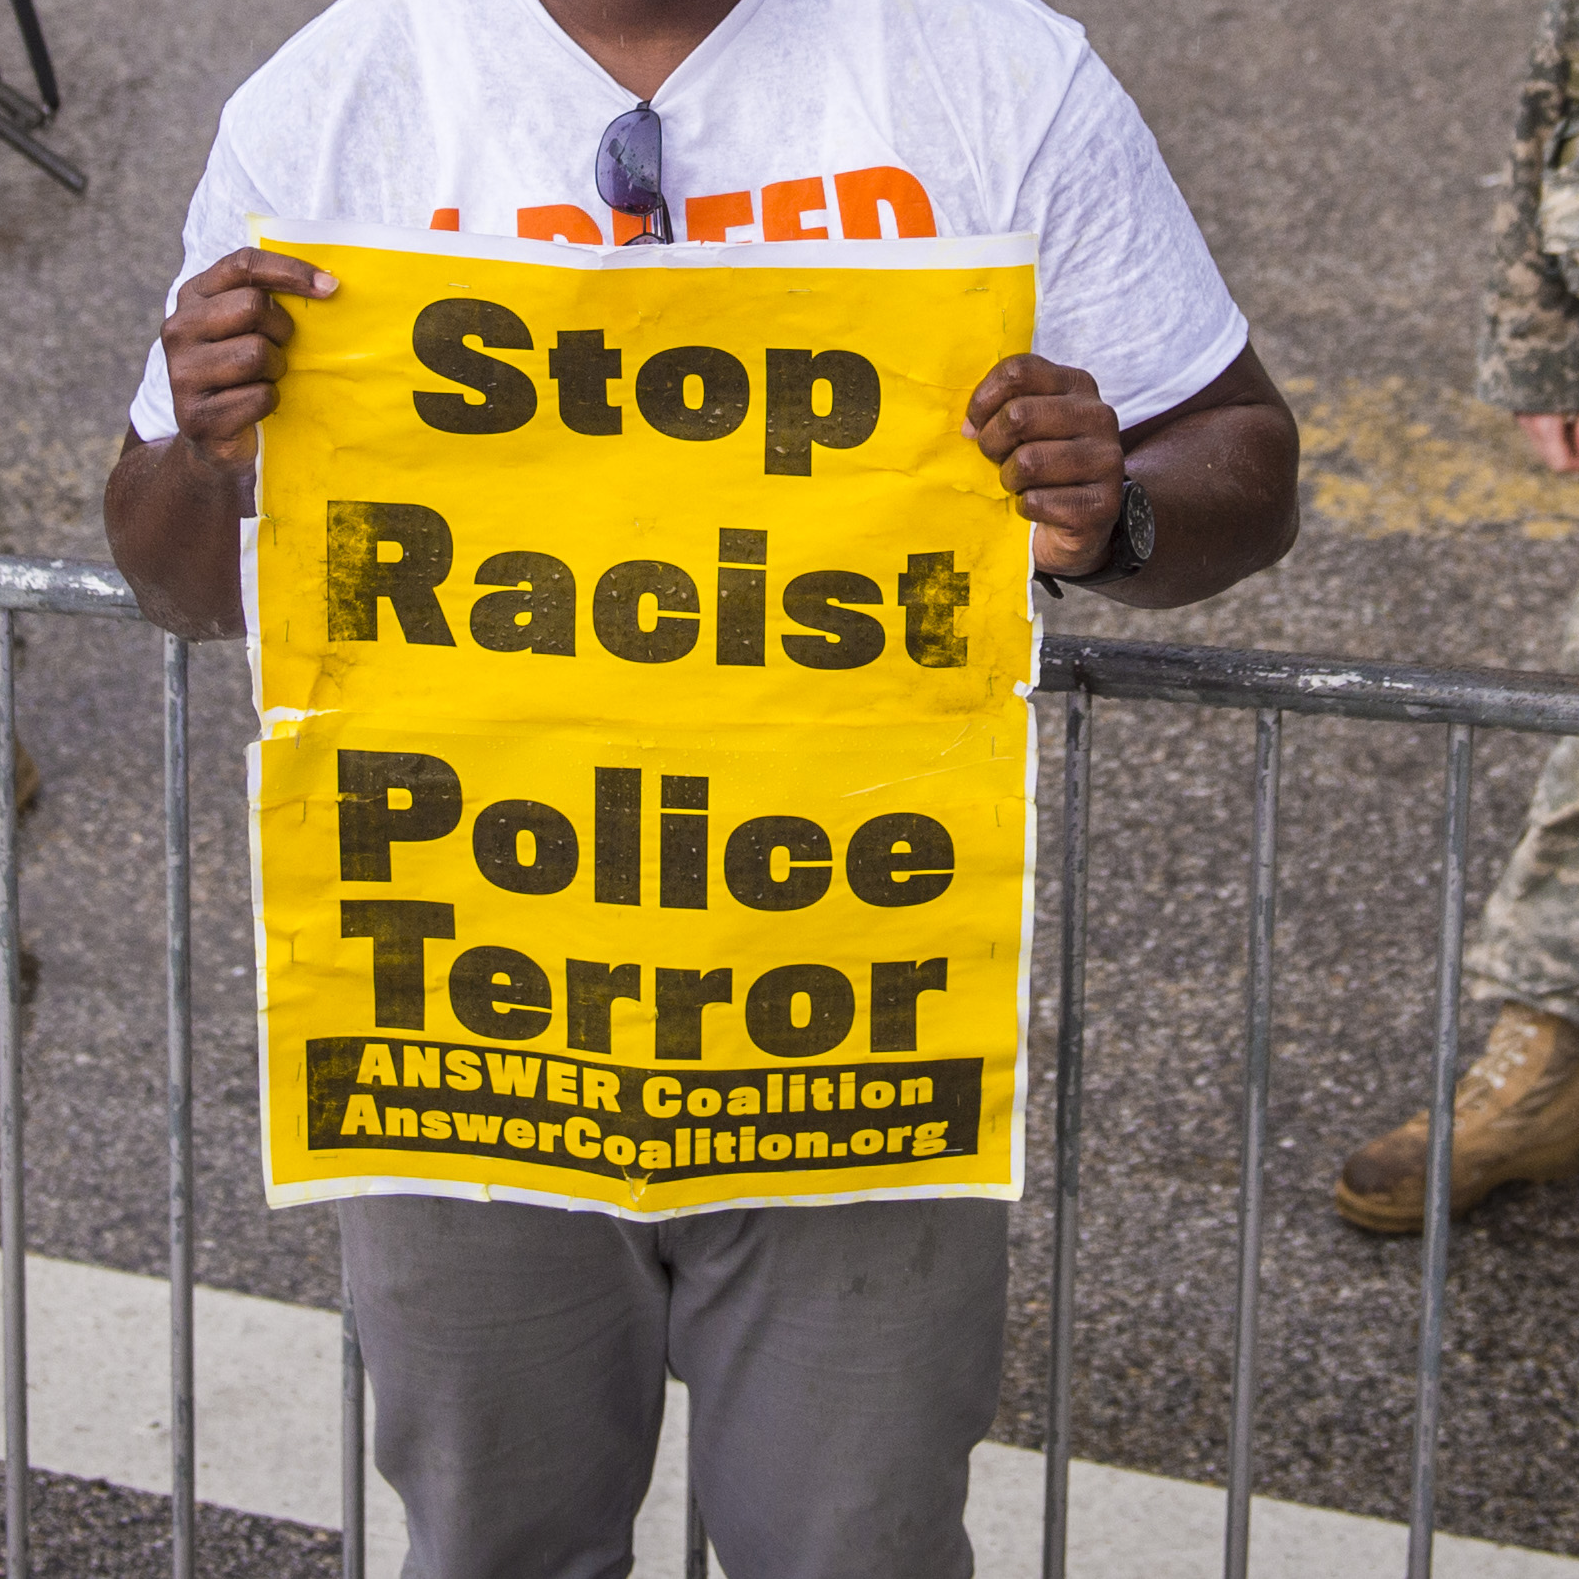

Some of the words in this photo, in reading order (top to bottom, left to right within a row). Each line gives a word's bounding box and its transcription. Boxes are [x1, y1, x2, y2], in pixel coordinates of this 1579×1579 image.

[412, 298, 881, 477] Stop
[326, 500, 970, 670] Racist
[336, 748, 956, 911] Police
[340, 899, 949, 1061] Terror
[340, 1093, 950, 1170] AnswerCoalition.org
[356, 1043, 622, 1113] ANSWER
[642, 1069, 934, 1123] Coalition
